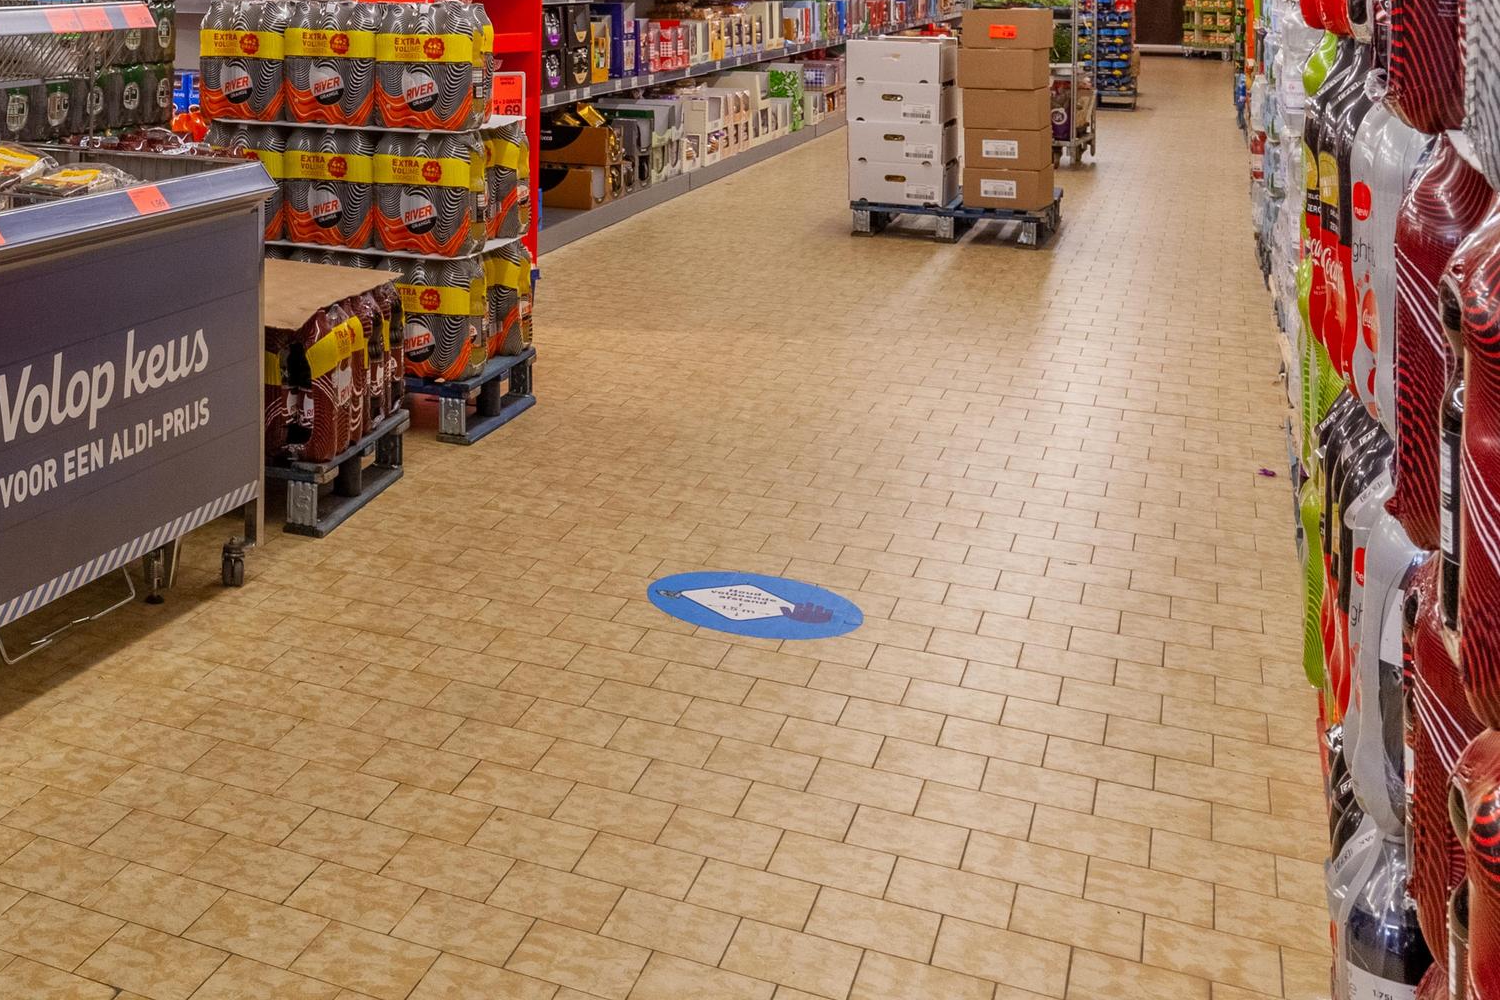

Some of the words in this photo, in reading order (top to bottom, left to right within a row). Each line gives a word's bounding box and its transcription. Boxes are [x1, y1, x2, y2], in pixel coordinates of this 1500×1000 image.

[213, 33, 238, 41] EXTRA
[302, 31, 328, 41] EXTRA
[224, 75, 249, 93] RIVER
[313, 76, 341, 94] RIVER
[406, 81, 434, 100] RIVER
[301, 155, 326, 164] EXTRA
[392, 159, 419, 168] EXTRA
[312, 199, 339, 216] RIVER
[405, 204, 433, 222] RIVER
[1354, 206, 1368, 217] new
[404, 333, 431, 351] RIVER
[123, 329, 209, 399] keus
[0, 458, 58, 509] VOOR
[63, 438, 104, 483] EEN
[109, 397, 210, 465] ALDI-PRIJS
